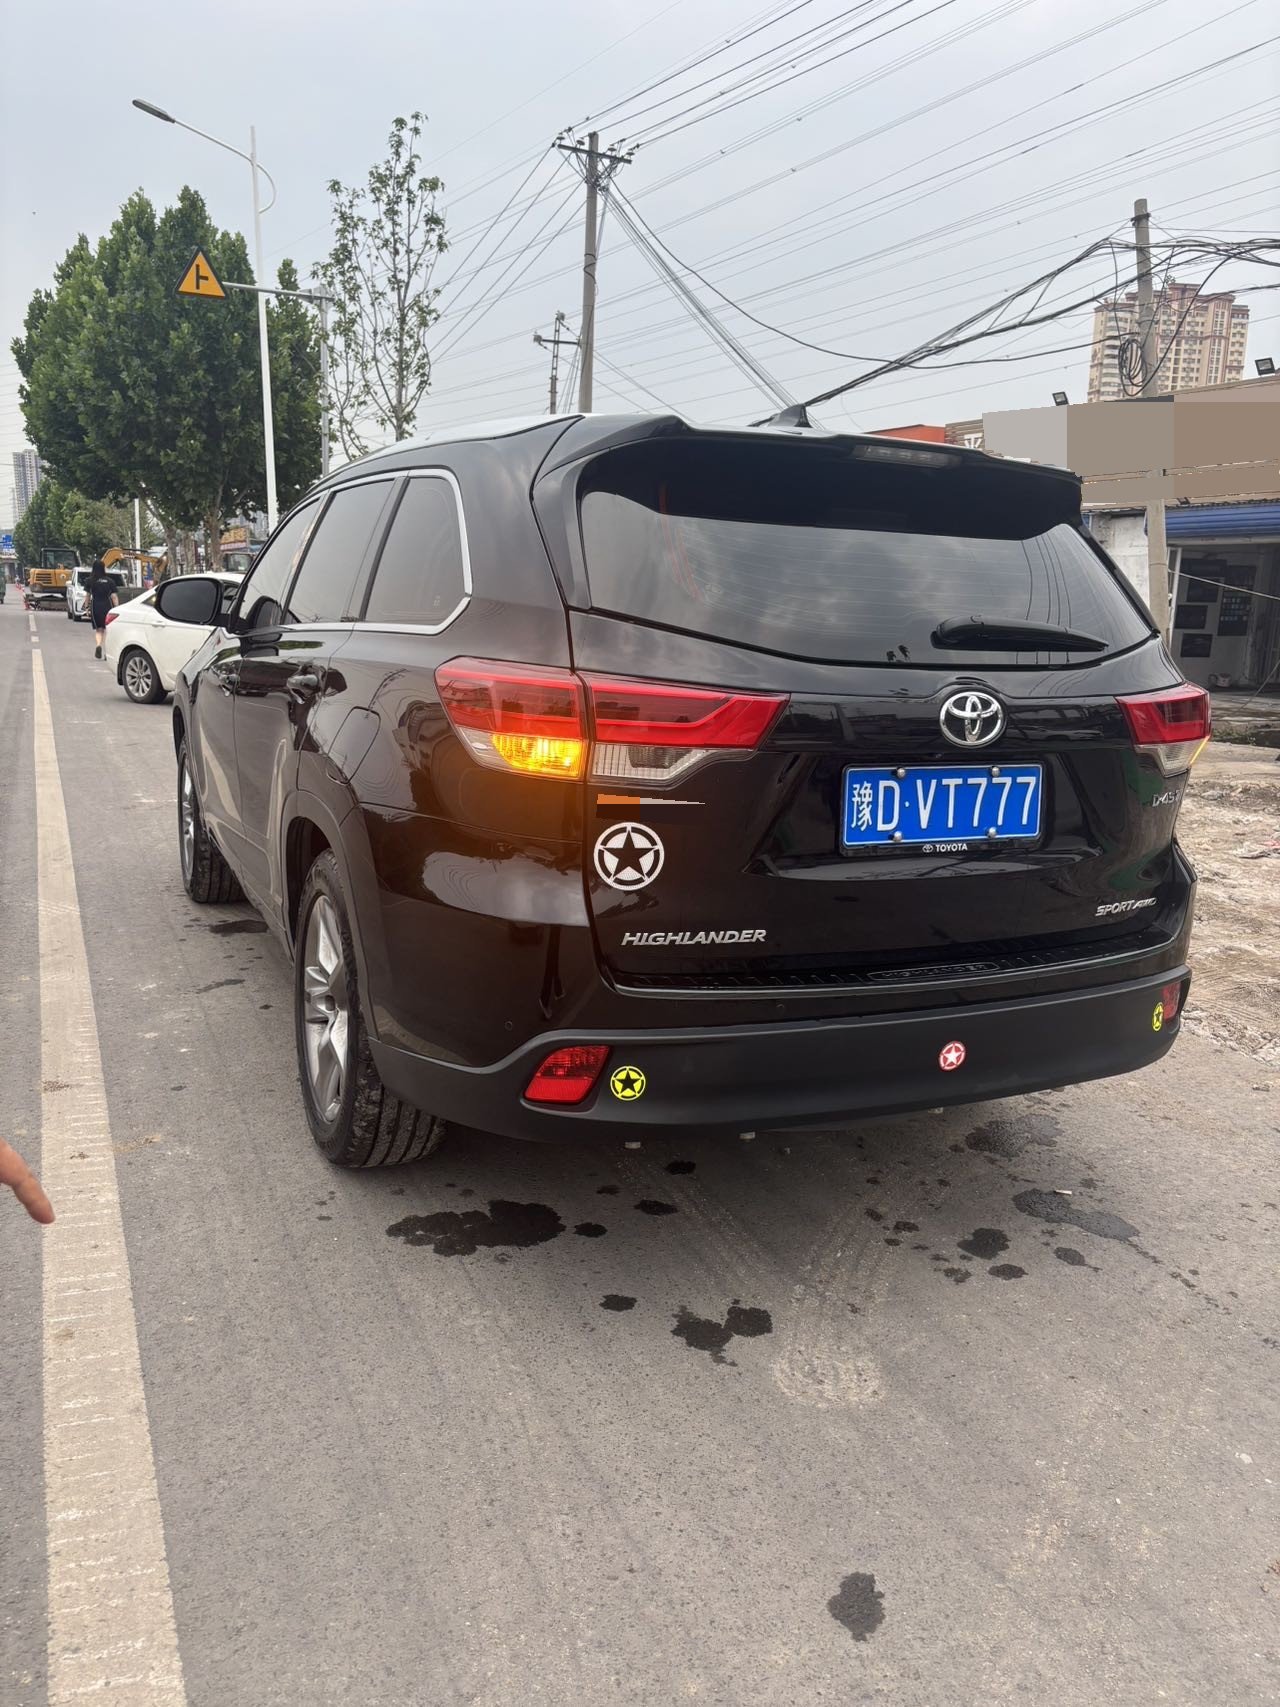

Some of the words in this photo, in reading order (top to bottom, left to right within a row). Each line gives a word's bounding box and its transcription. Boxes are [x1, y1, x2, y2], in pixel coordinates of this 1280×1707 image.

[851, 776, 1037, 832] 豫D·VT777
[935, 843, 968, 852] TOYOTA
[1095, 899, 1135, 916] SPORT
[621, 929, 767, 945] HIGHLANDER
